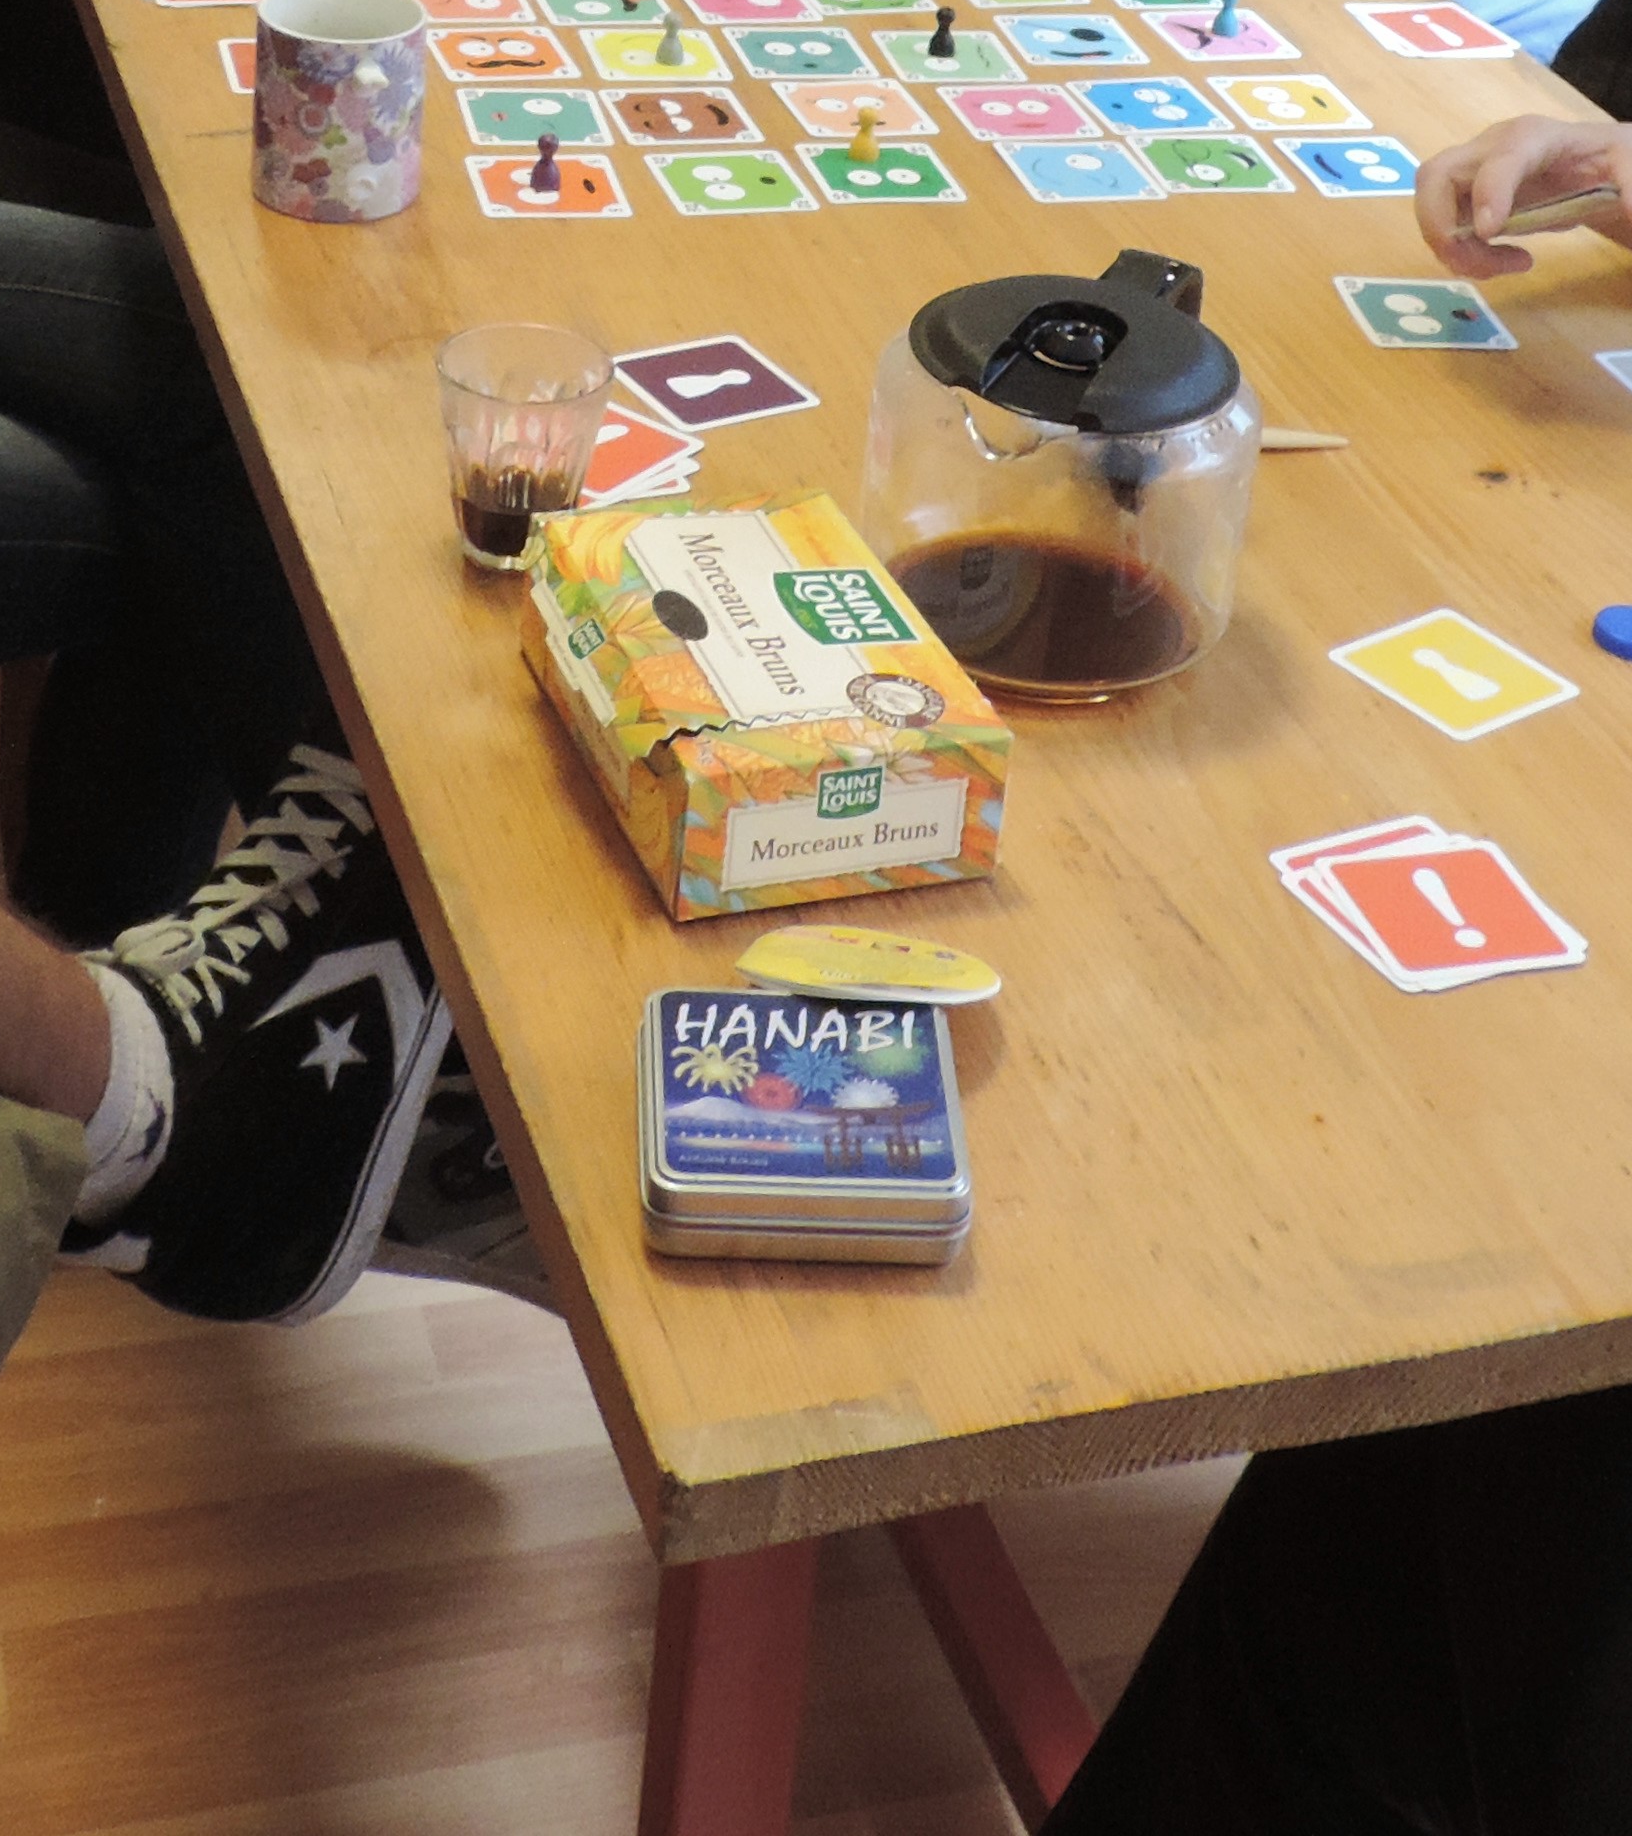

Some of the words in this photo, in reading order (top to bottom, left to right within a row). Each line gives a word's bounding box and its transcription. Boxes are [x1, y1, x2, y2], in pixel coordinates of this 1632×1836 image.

[678, 532, 760, 630] Morceaux
[747, 634, 806, 697] Bruns
[792, 573, 863, 644] LOUIS
[828, 572, 900, 642] SAINT
[820, 788, 878, 812] LOUIS
[822, 772, 880, 796] SAINT
[751, 832, 864, 863] Morceaux
[872, 820, 940, 846] Bruns
[675, 1003, 915, 1053] HANABI
